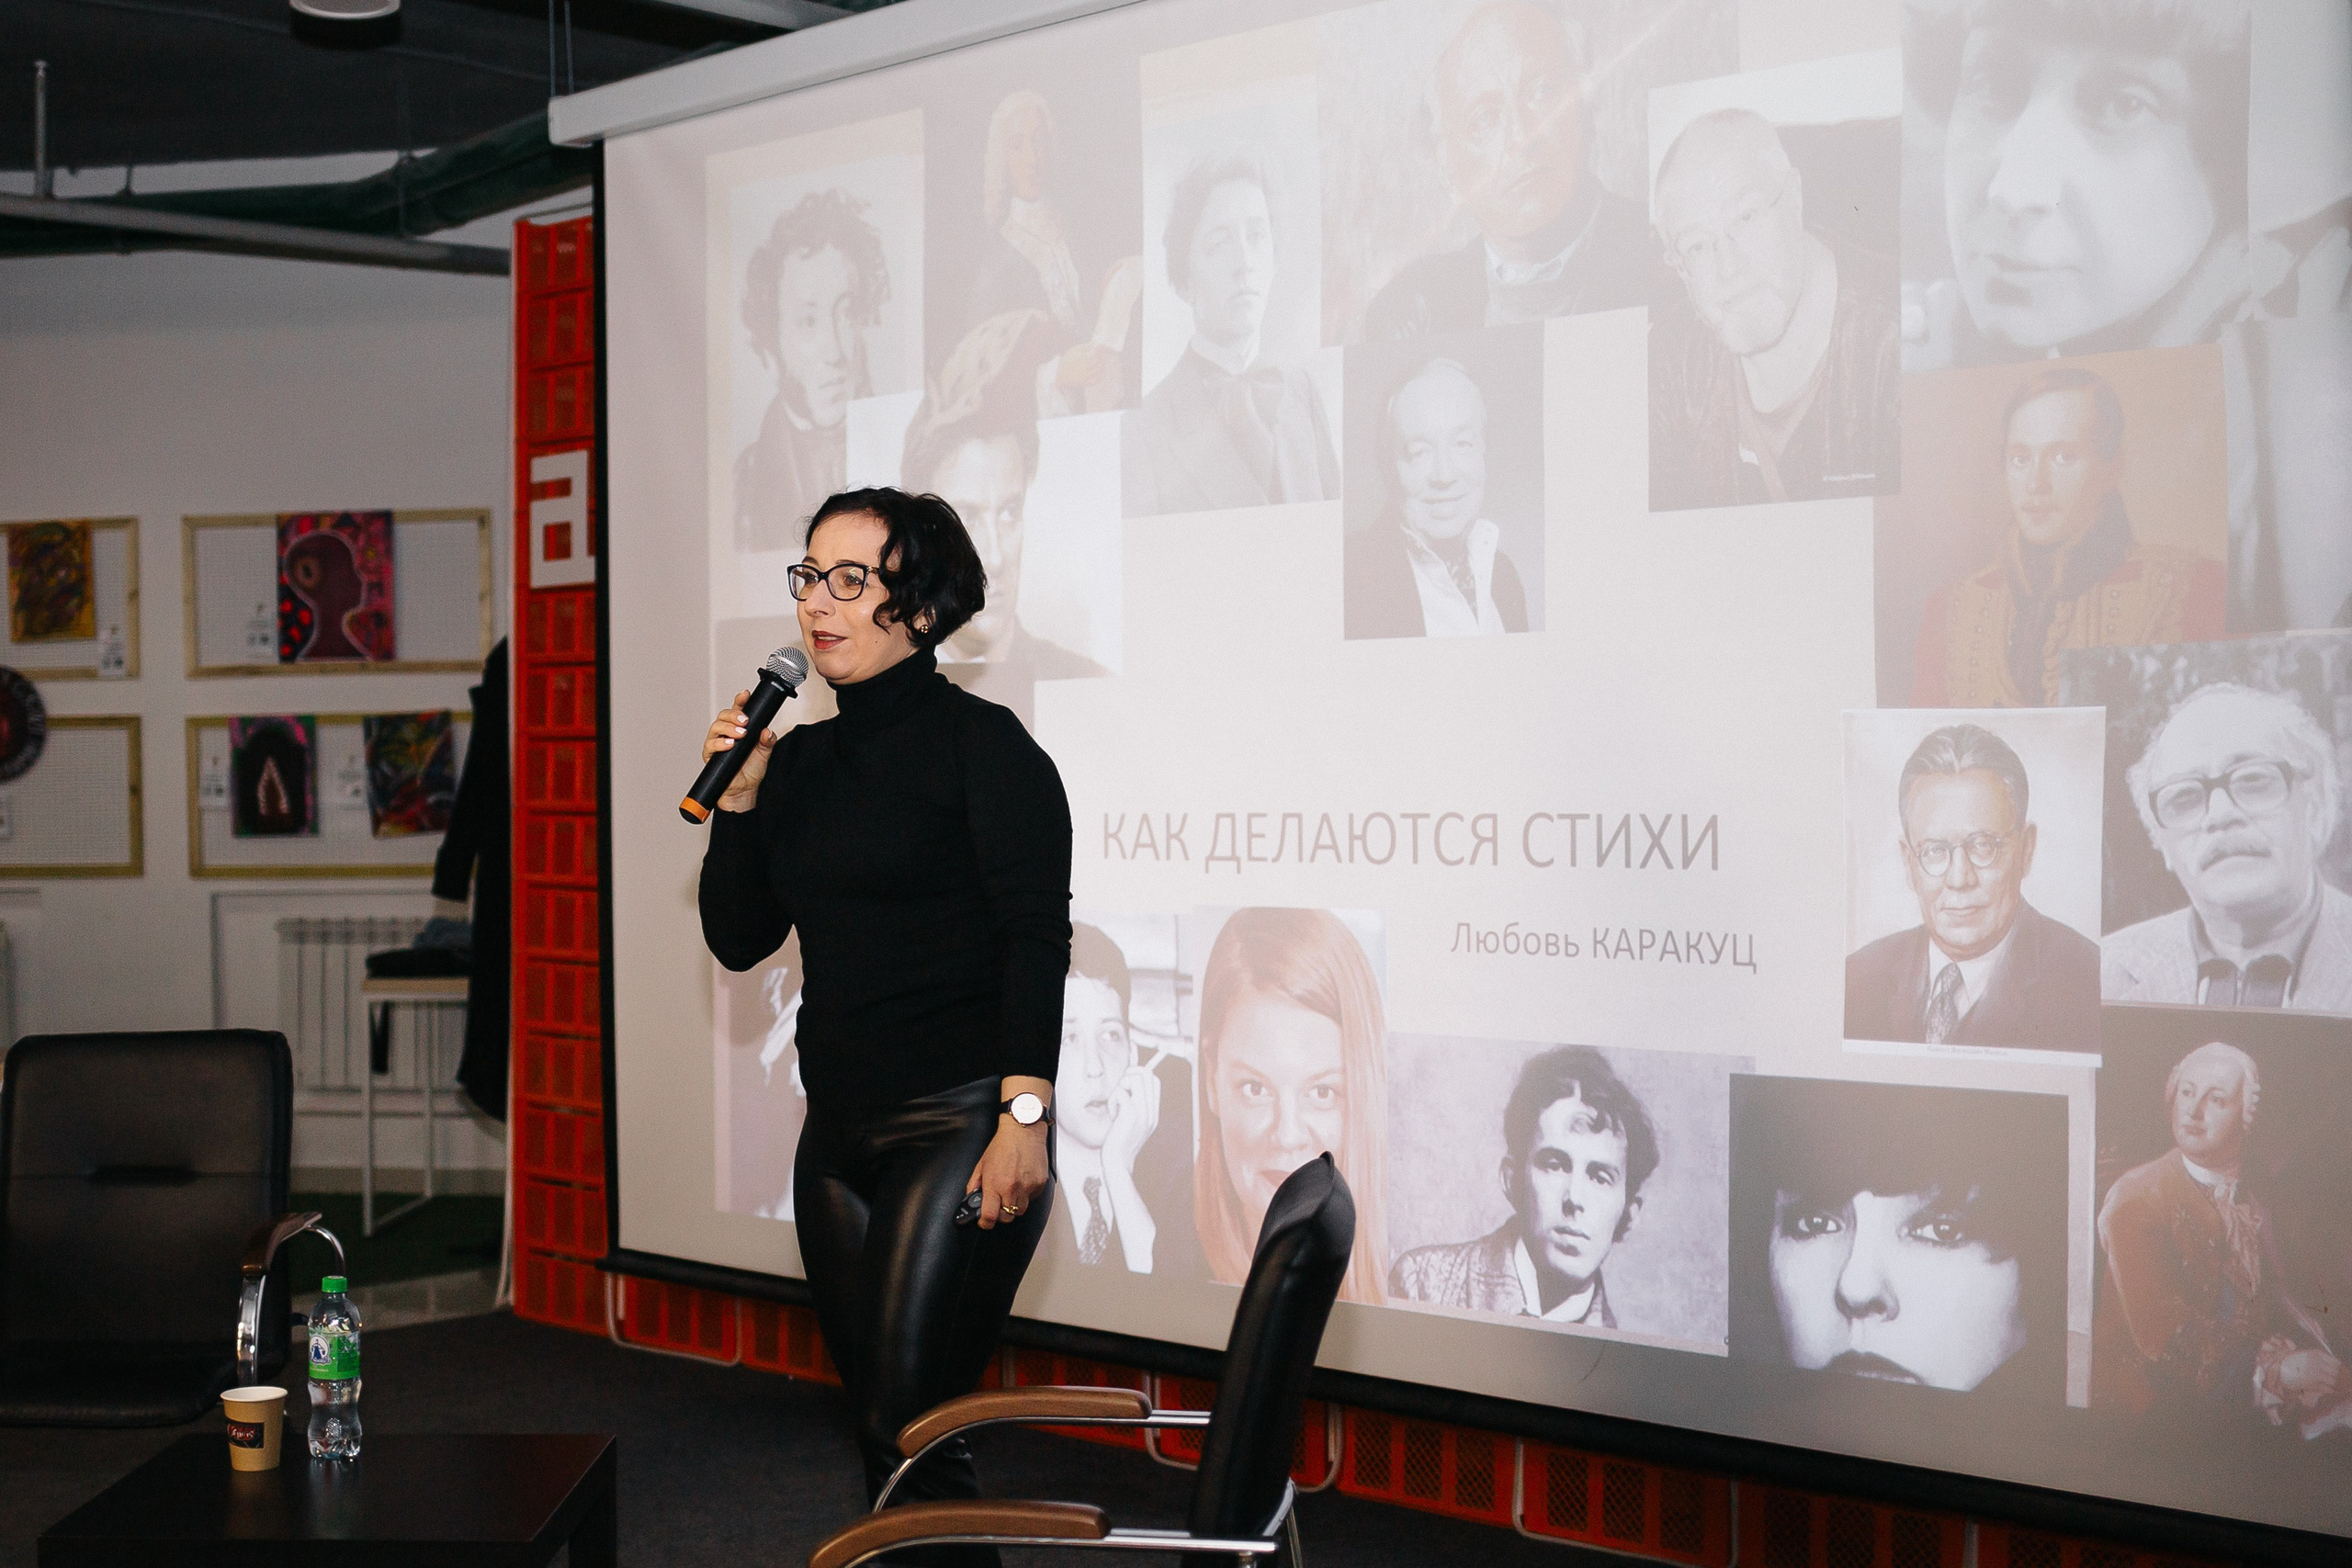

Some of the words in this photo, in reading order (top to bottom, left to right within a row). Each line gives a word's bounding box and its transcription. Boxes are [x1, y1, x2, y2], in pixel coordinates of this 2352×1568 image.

[1102, 812, 1190, 862] КАК
[1204, 812, 1499, 874] ДЕЛАЮТСЯ
[1521, 813, 1720, 871] СТИХИ
[1451, 921, 1581, 958] Любовь
[1591, 927, 1758, 975] КАРАКУЦ
